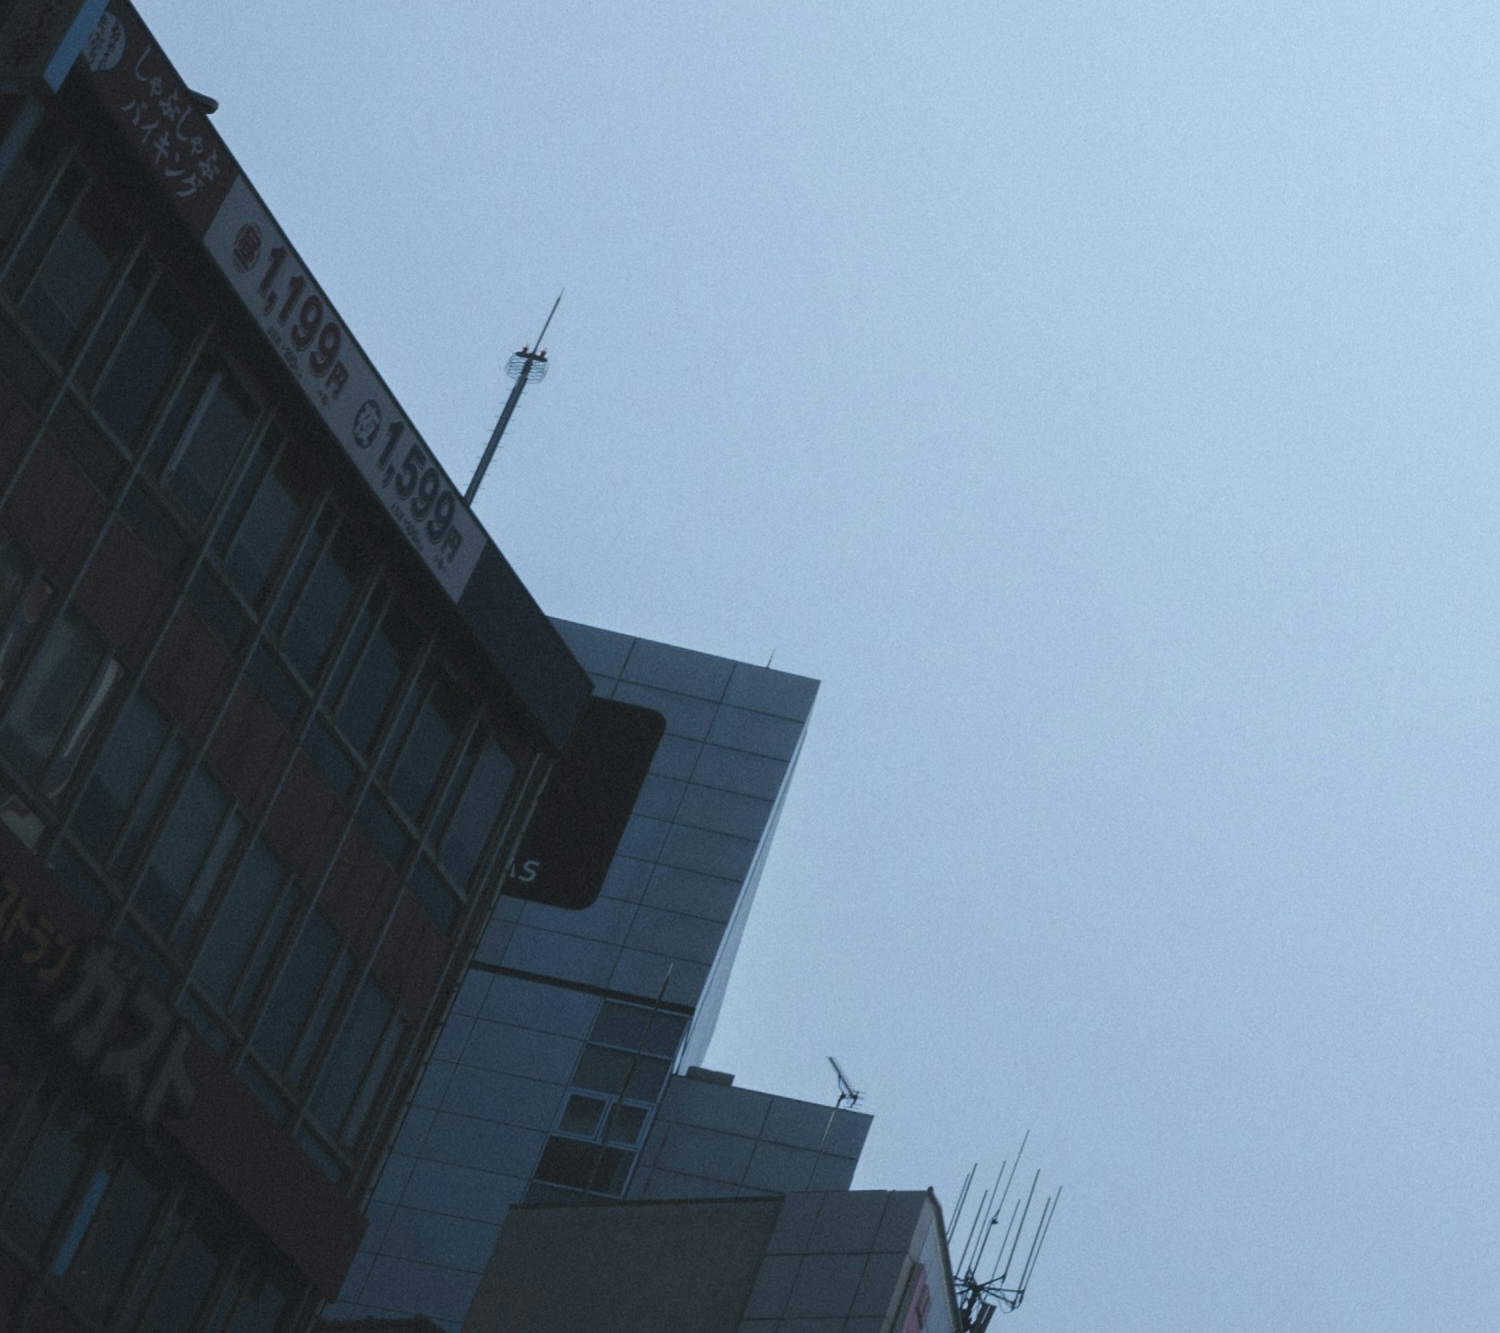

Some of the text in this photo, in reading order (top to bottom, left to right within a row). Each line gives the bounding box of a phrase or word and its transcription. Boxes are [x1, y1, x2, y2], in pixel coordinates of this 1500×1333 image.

[121, 99, 200, 198] バイキング
